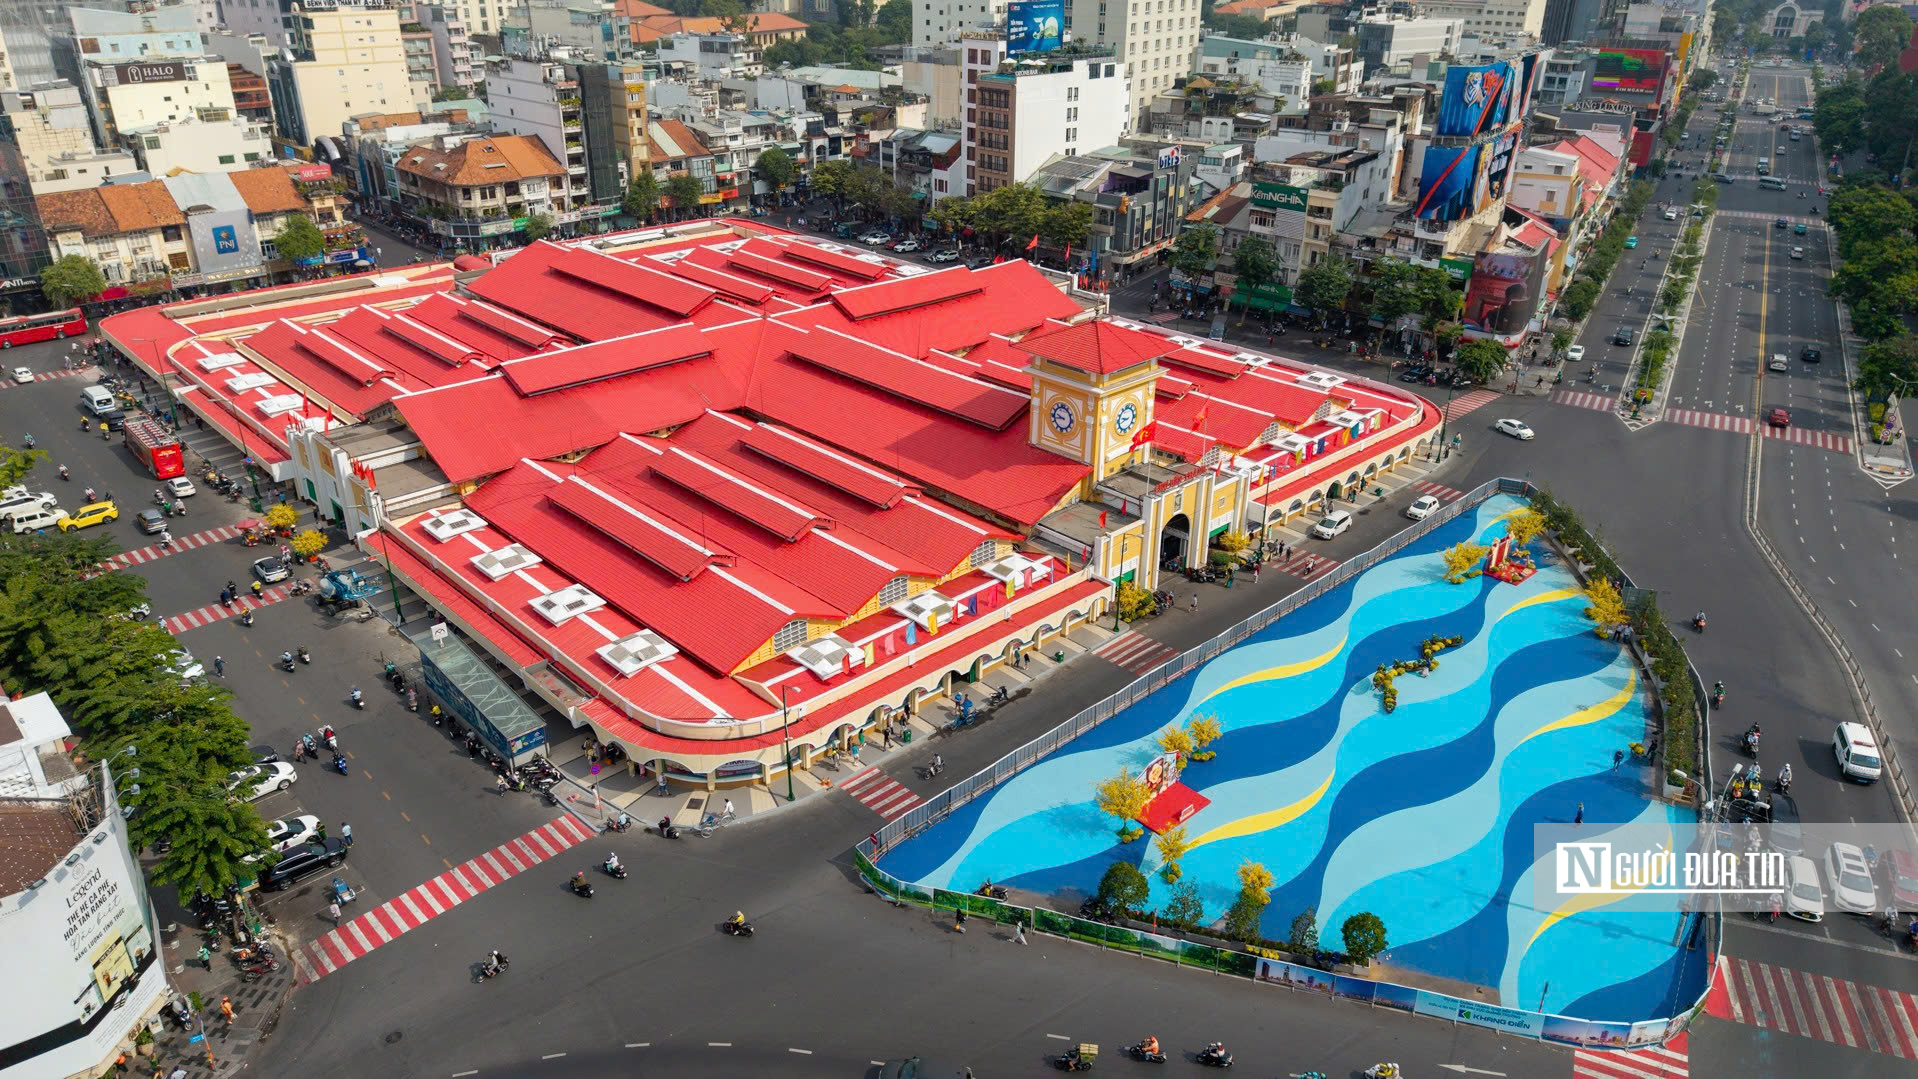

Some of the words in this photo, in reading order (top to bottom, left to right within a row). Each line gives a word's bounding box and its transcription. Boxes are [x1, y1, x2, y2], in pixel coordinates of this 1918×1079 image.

[143, 66, 174, 77] HALO
[1575, 100, 1597, 111] KING
[1600, 102, 1634, 112] LUXURY
[219, 240, 235, 249] PNJ
[66, 868, 101, 909] Legend
[77, 911, 92, 927] TAN
[91, 894, 108, 914] RANG
[106, 881, 119, 899] XAY
[1473, 1013, 1507, 1025] KHANG
